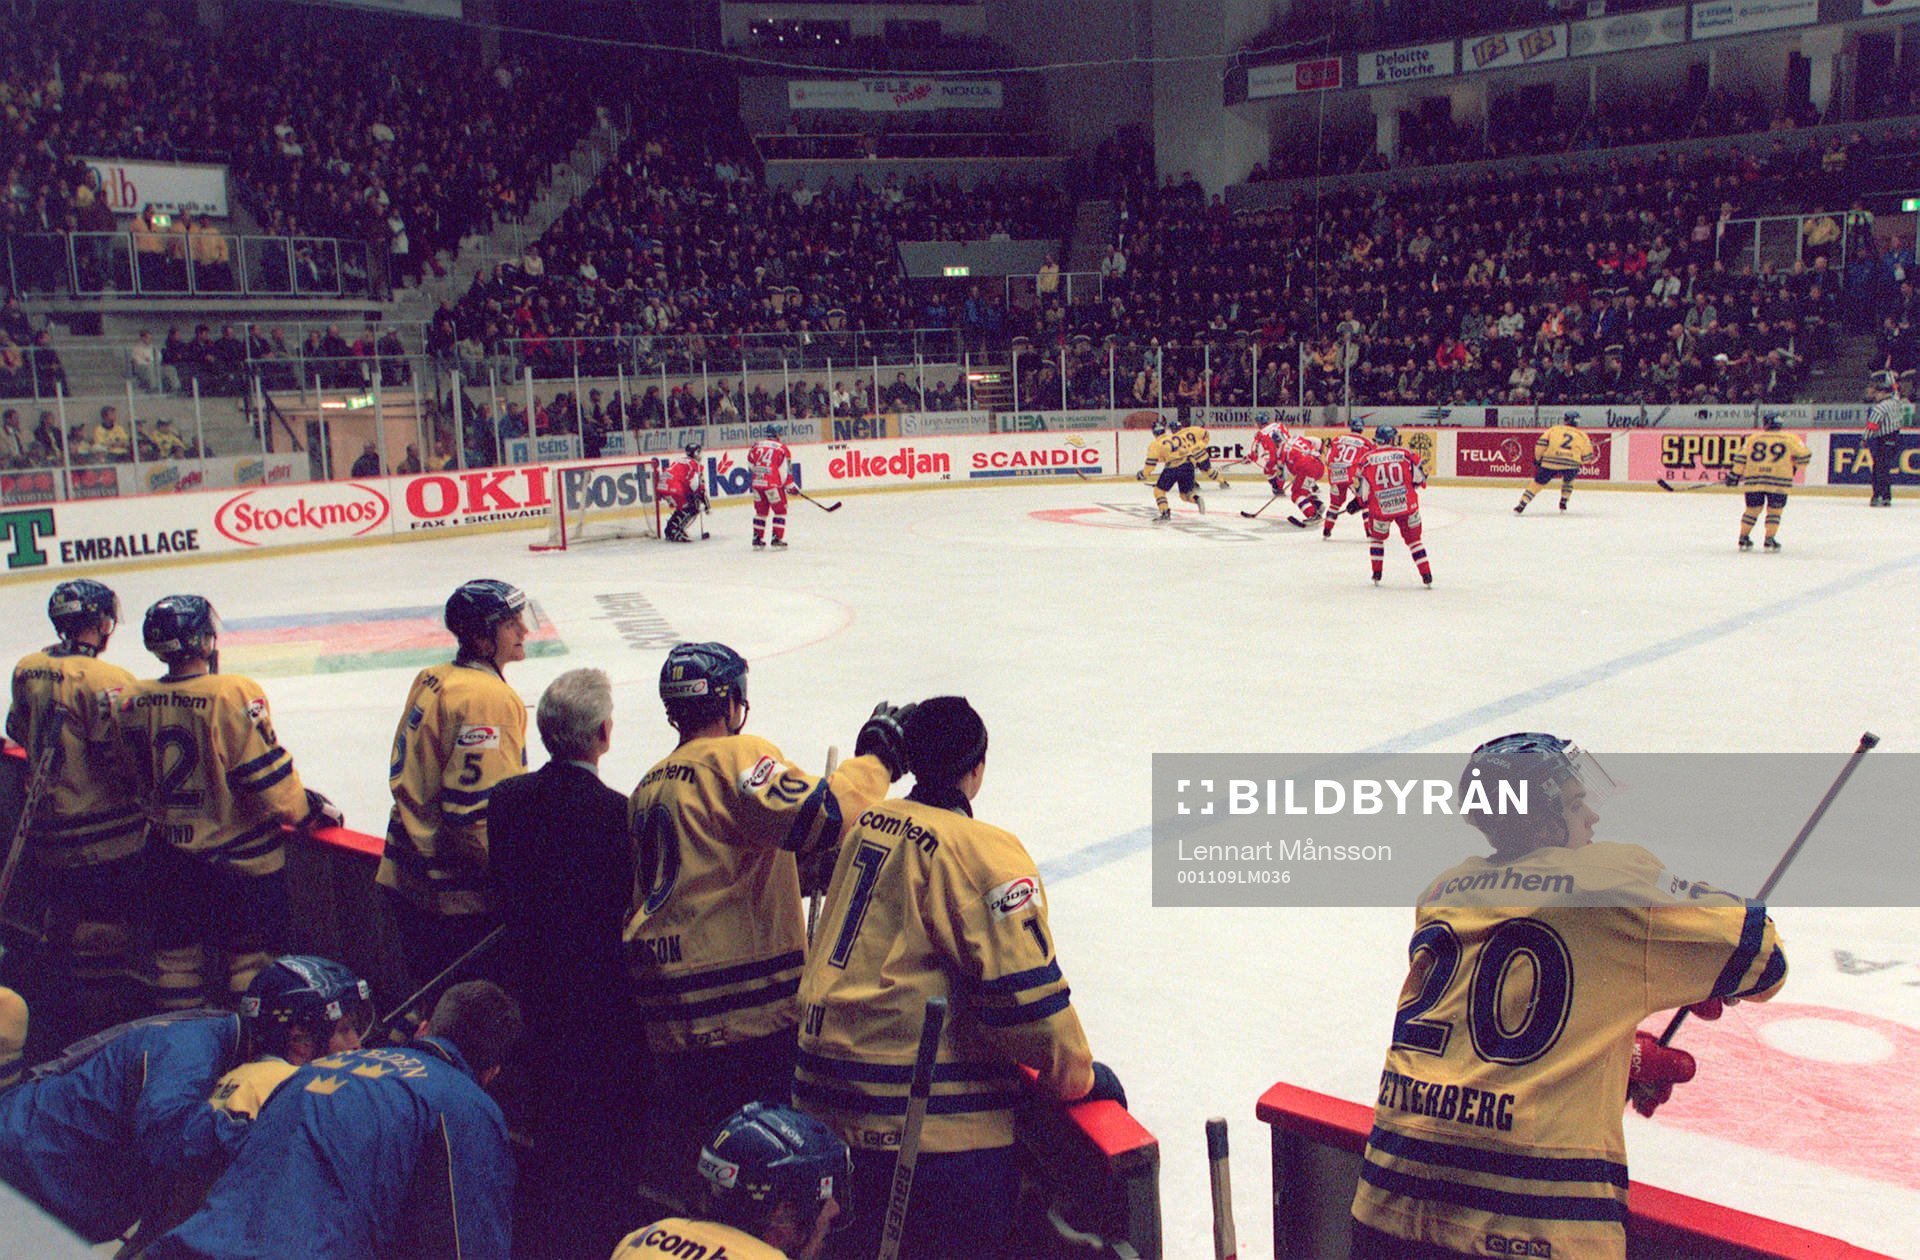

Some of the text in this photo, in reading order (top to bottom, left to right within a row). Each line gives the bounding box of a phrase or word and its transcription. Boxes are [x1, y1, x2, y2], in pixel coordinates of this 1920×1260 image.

[1376, 49, 1429, 67] Deloitte
[1376, 63, 1434, 81] & Touche
[862, 81, 910, 93] TELE
[941, 86, 992, 97] NOKIA
[1208, 442, 1244, 459] ert
[1333, 444, 1358, 463] 30
[1560, 433, 1574, 450] 2
[1661, 433, 1751, 469] SPOR
[1750, 441, 1787, 463] 89
[755, 447, 774, 467] 24
[828, 447, 950, 480] elkedjan
[971, 448, 1100, 469] SCANDIC
[1460, 448, 1507, 462] TELIA
[1374, 462, 1404, 489] 40
[1489, 463, 1522, 474] mobile
[405, 466, 550, 520] OKI
[233, 498, 377, 533] Stockmos
[410, 506, 551, 530] FAX SKRIVARE
[60, 528, 200, 563] EMBALLAGE
[136, 691, 208, 709] com hem
[458, 752, 484, 787] 5
[766, 770, 810, 804] 10
[858, 809, 940, 857] com hem
[1445, 865, 1575, 897] com hem
[828, 839, 890, 970] 1
[1022, 917, 1050, 957] 1
[1391, 916, 1575, 1068] 20
[1379, 1069, 1516, 1132] ETTERBERG
[644, 1226, 709, 1260] com
[1486, 1235, 1552, 1259] CCM
